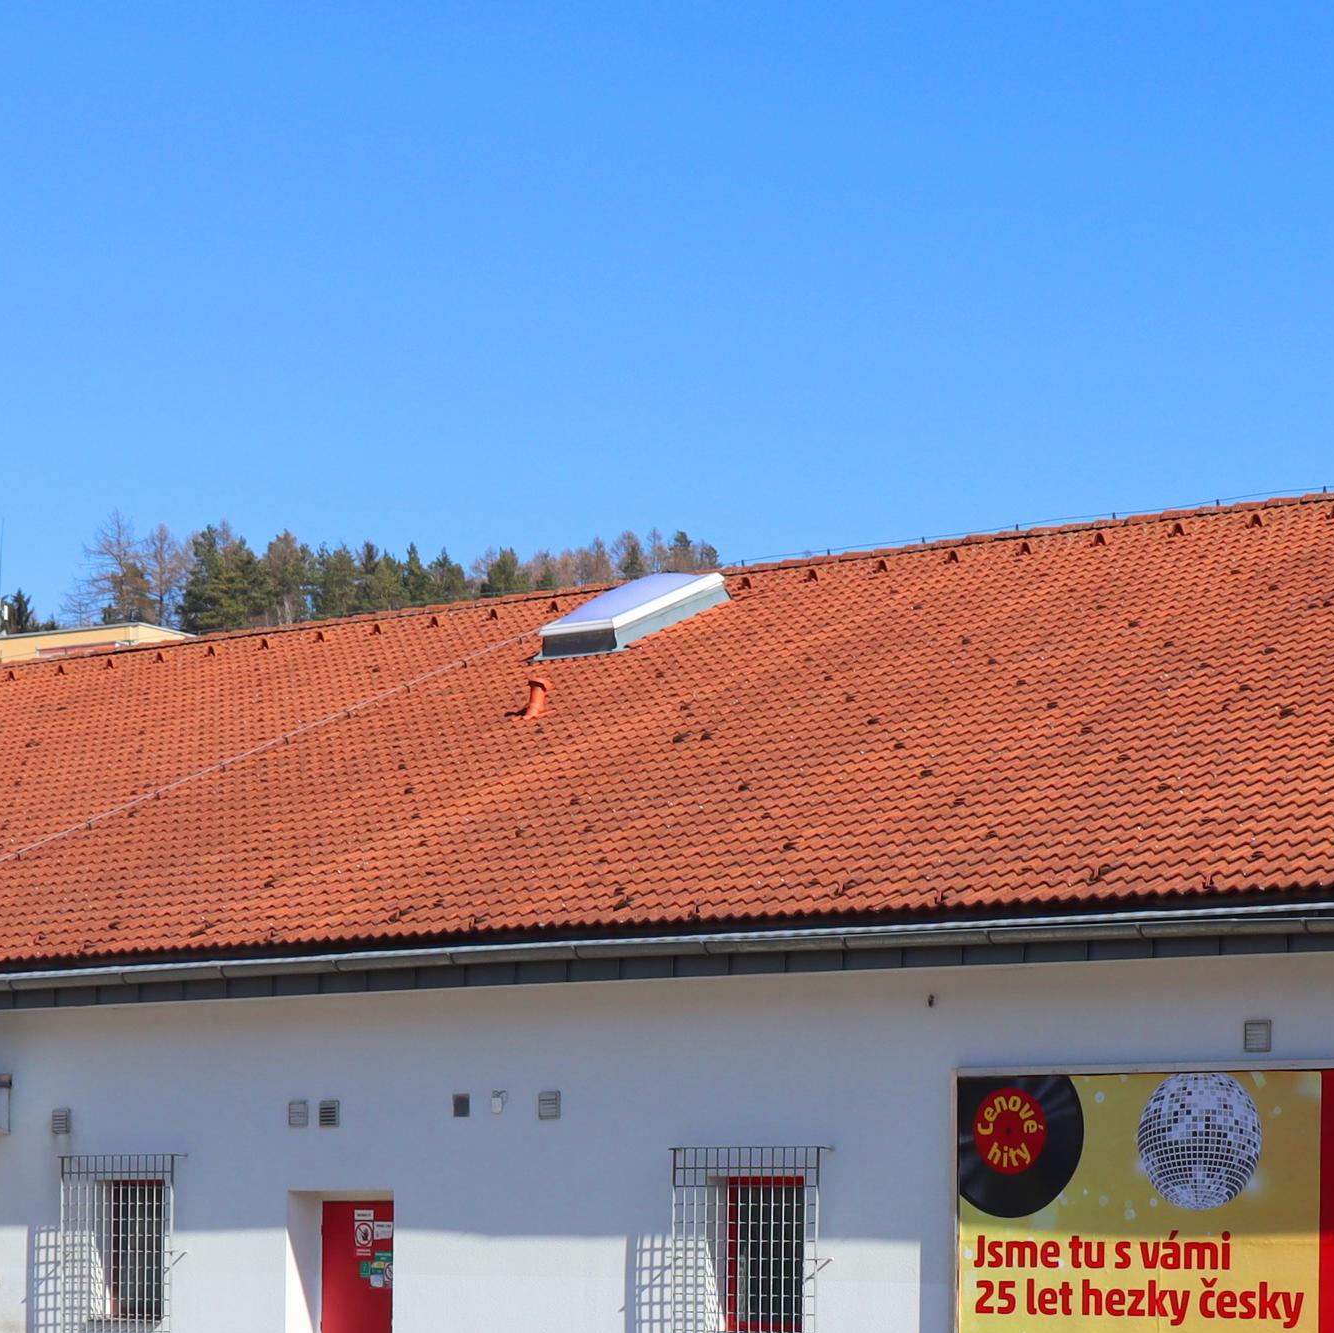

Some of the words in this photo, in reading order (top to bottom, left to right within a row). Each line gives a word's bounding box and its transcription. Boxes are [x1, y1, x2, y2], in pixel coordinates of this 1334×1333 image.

[977, 1095, 1044, 1136] Cenové
[987, 1142, 1031, 1168] hity
[974, 1235, 1060, 1268] Jsme
[1069, 1235, 1105, 1268] tu
[1115, 1241, 1131, 1269] s
[1140, 1230, 1231, 1270] vámi
[975, 1280, 1016, 1314] 25
[1026, 1278, 1072, 1316] let
[1081, 1279, 1190, 1326] hezky
[1199, 1277, 1304, 1328] česky
